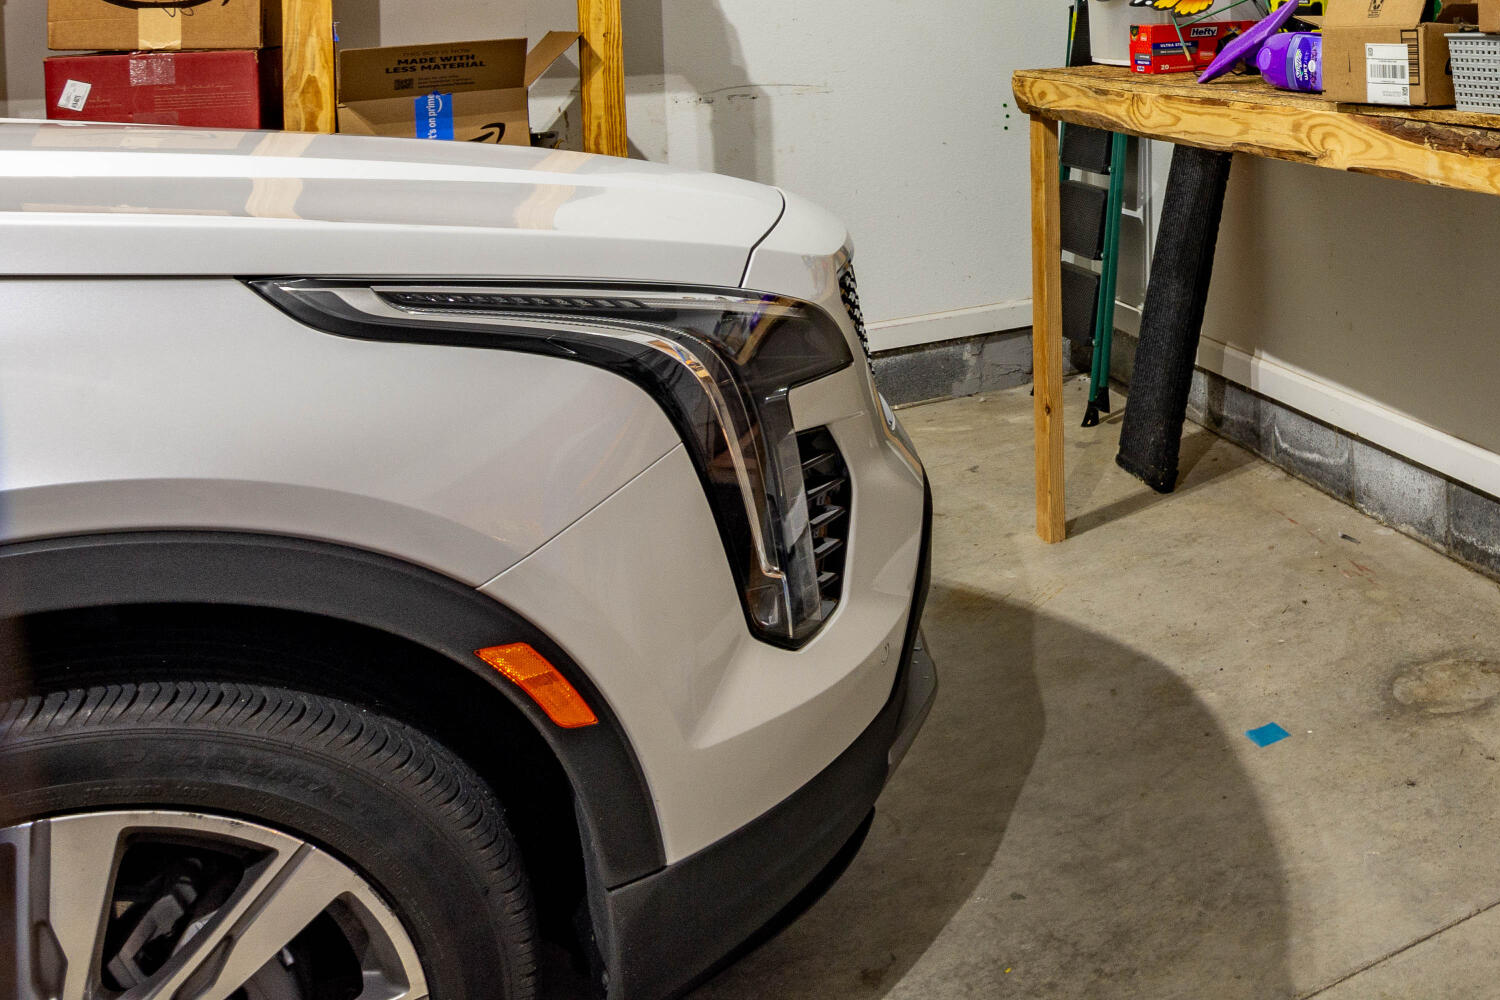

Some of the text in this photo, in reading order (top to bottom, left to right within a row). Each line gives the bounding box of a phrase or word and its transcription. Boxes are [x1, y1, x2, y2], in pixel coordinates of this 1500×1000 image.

[1191, 27, 1217, 36] Hefty
[397, 54, 475, 65] MADE WITH
[385, 61, 486, 74] LESS MATERIAL
[425, 94, 438, 116] prime
[428, 117, 437, 127] on
